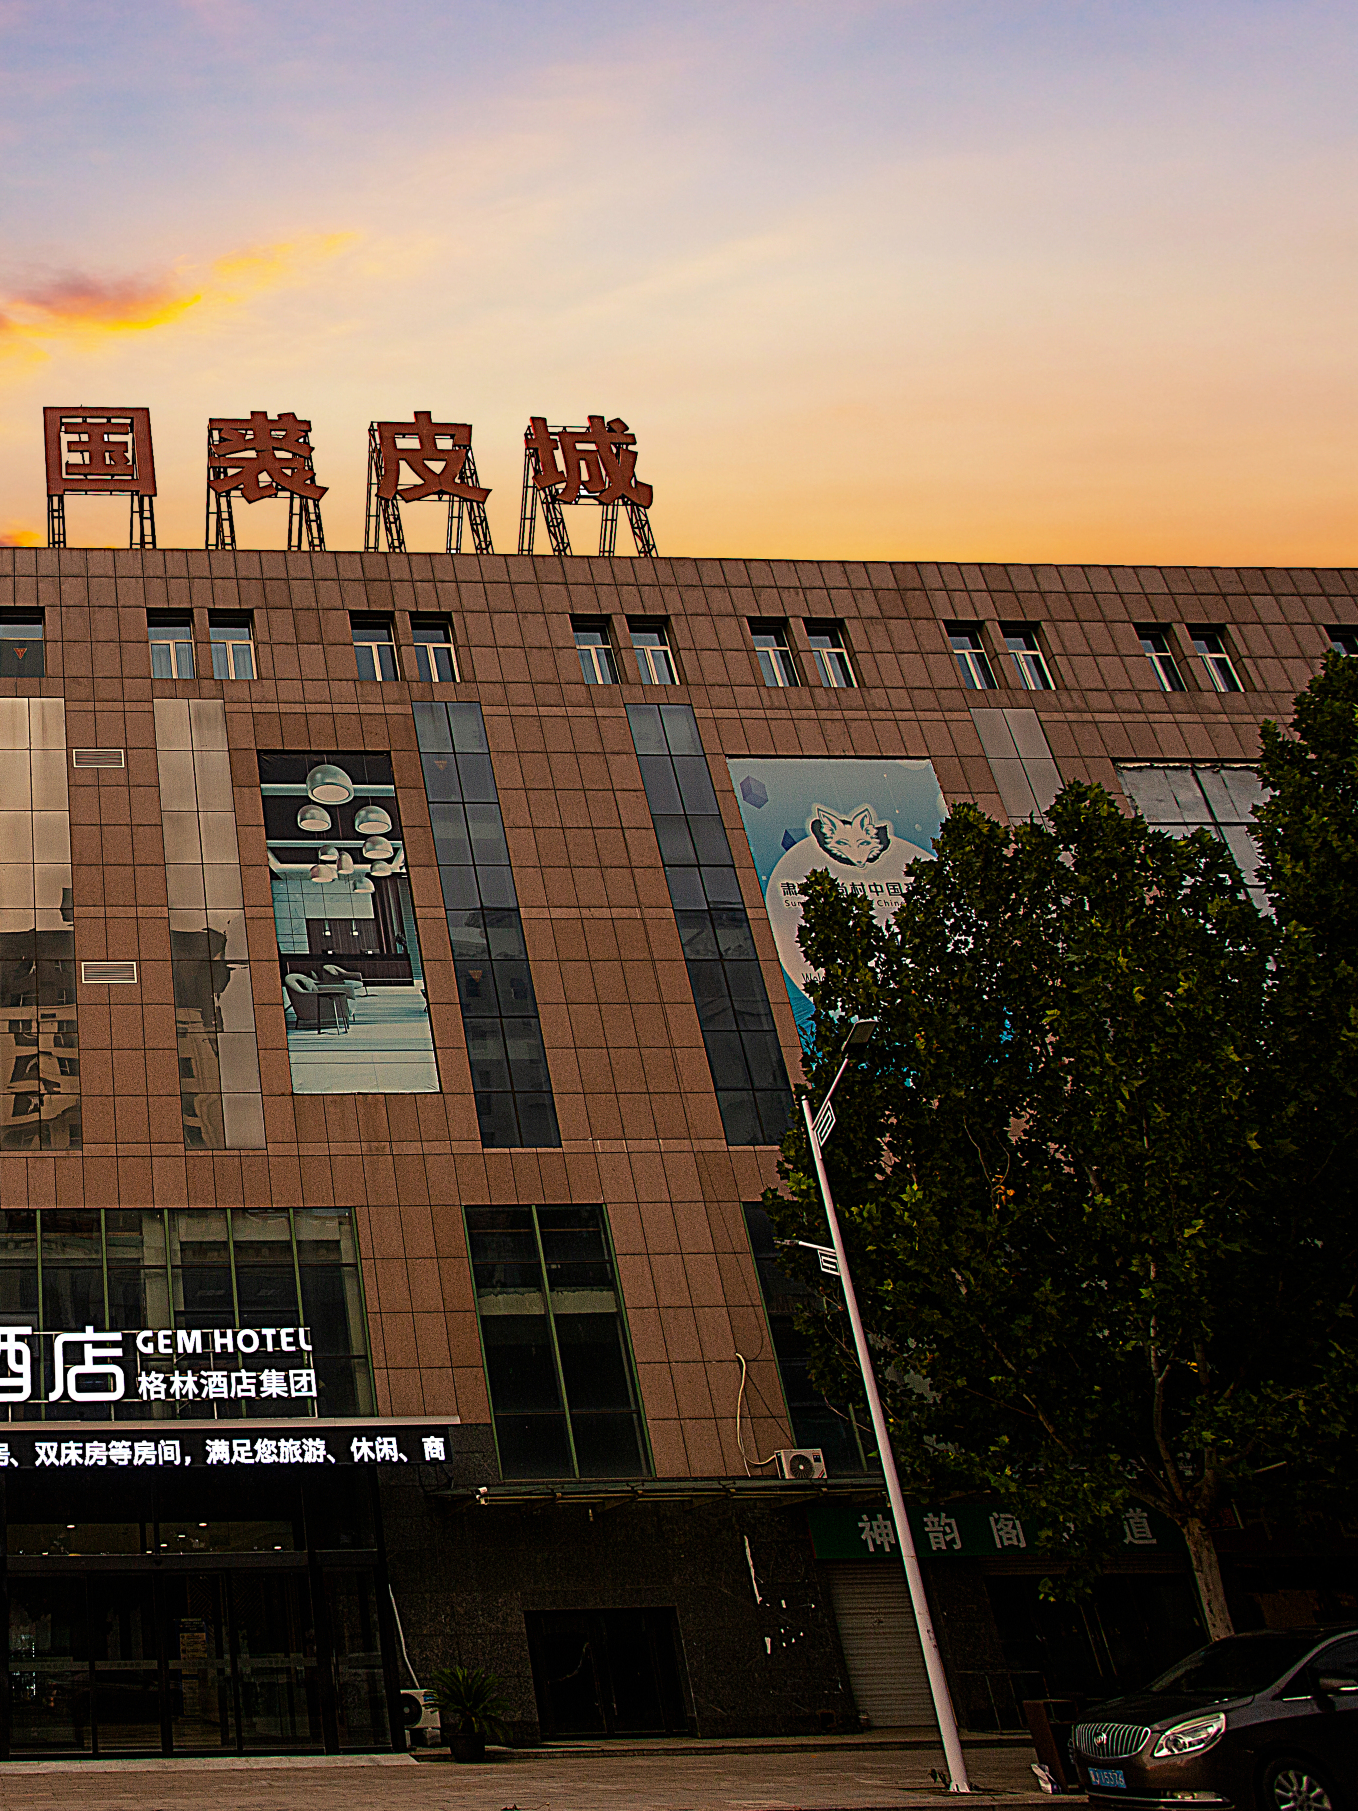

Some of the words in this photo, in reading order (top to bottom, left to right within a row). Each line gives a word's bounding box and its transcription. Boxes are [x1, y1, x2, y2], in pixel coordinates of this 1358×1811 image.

[136, 1329, 203, 1354] GEM
[213, 1327, 314, 1353] HOTEL
[137, 1368, 318, 1401] 格林酒店集团
[857, 1507, 1158, 1553] 神韵阁道
